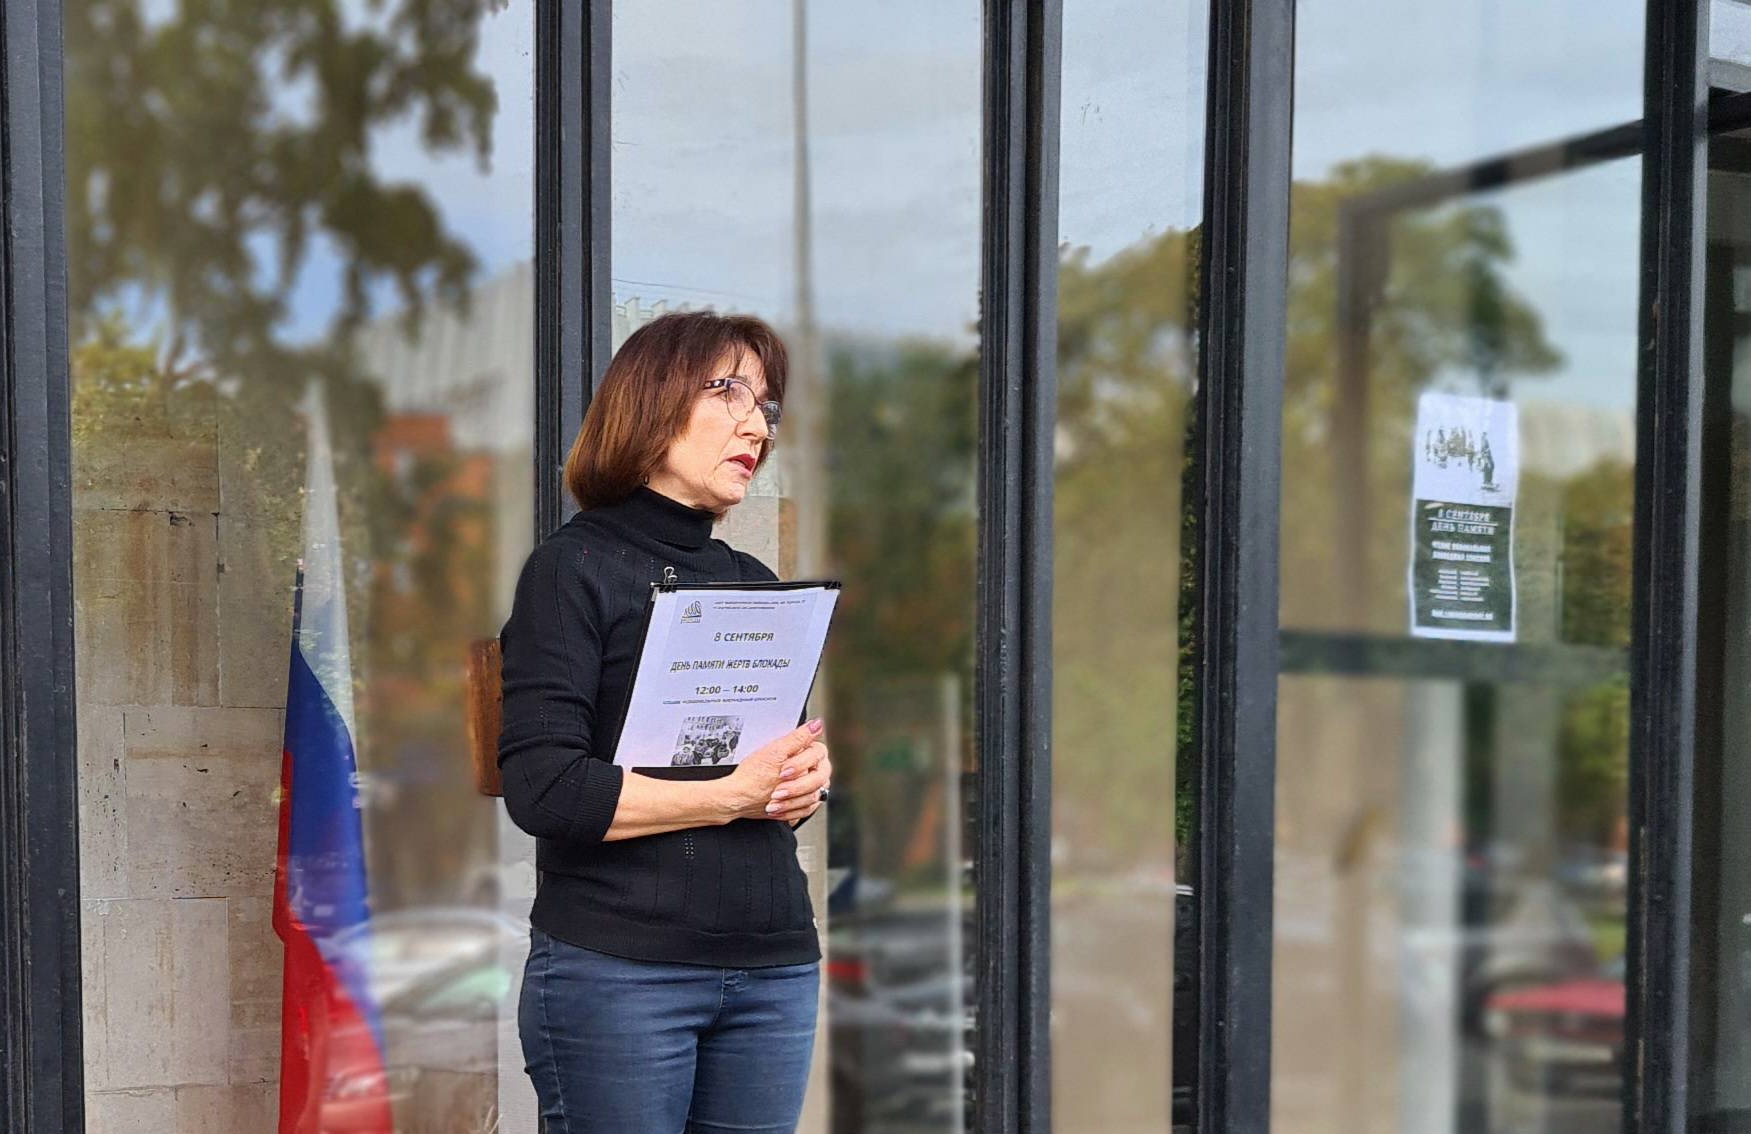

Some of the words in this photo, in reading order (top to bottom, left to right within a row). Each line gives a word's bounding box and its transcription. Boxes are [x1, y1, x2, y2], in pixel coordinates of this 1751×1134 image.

[713, 632, 721, 642] 8
[724, 632, 774, 642] СЕНТЯБРЯ
[670, 661, 691, 672] ДЕНЬ
[692, 660, 725, 670] ПАМЯТИ
[726, 660, 750, 669] ЖЕРТВ
[752, 659, 791, 669] БЛОКАДЫ
[695, 686, 721, 695] 12:00
[733, 685, 759, 694] 14:00
